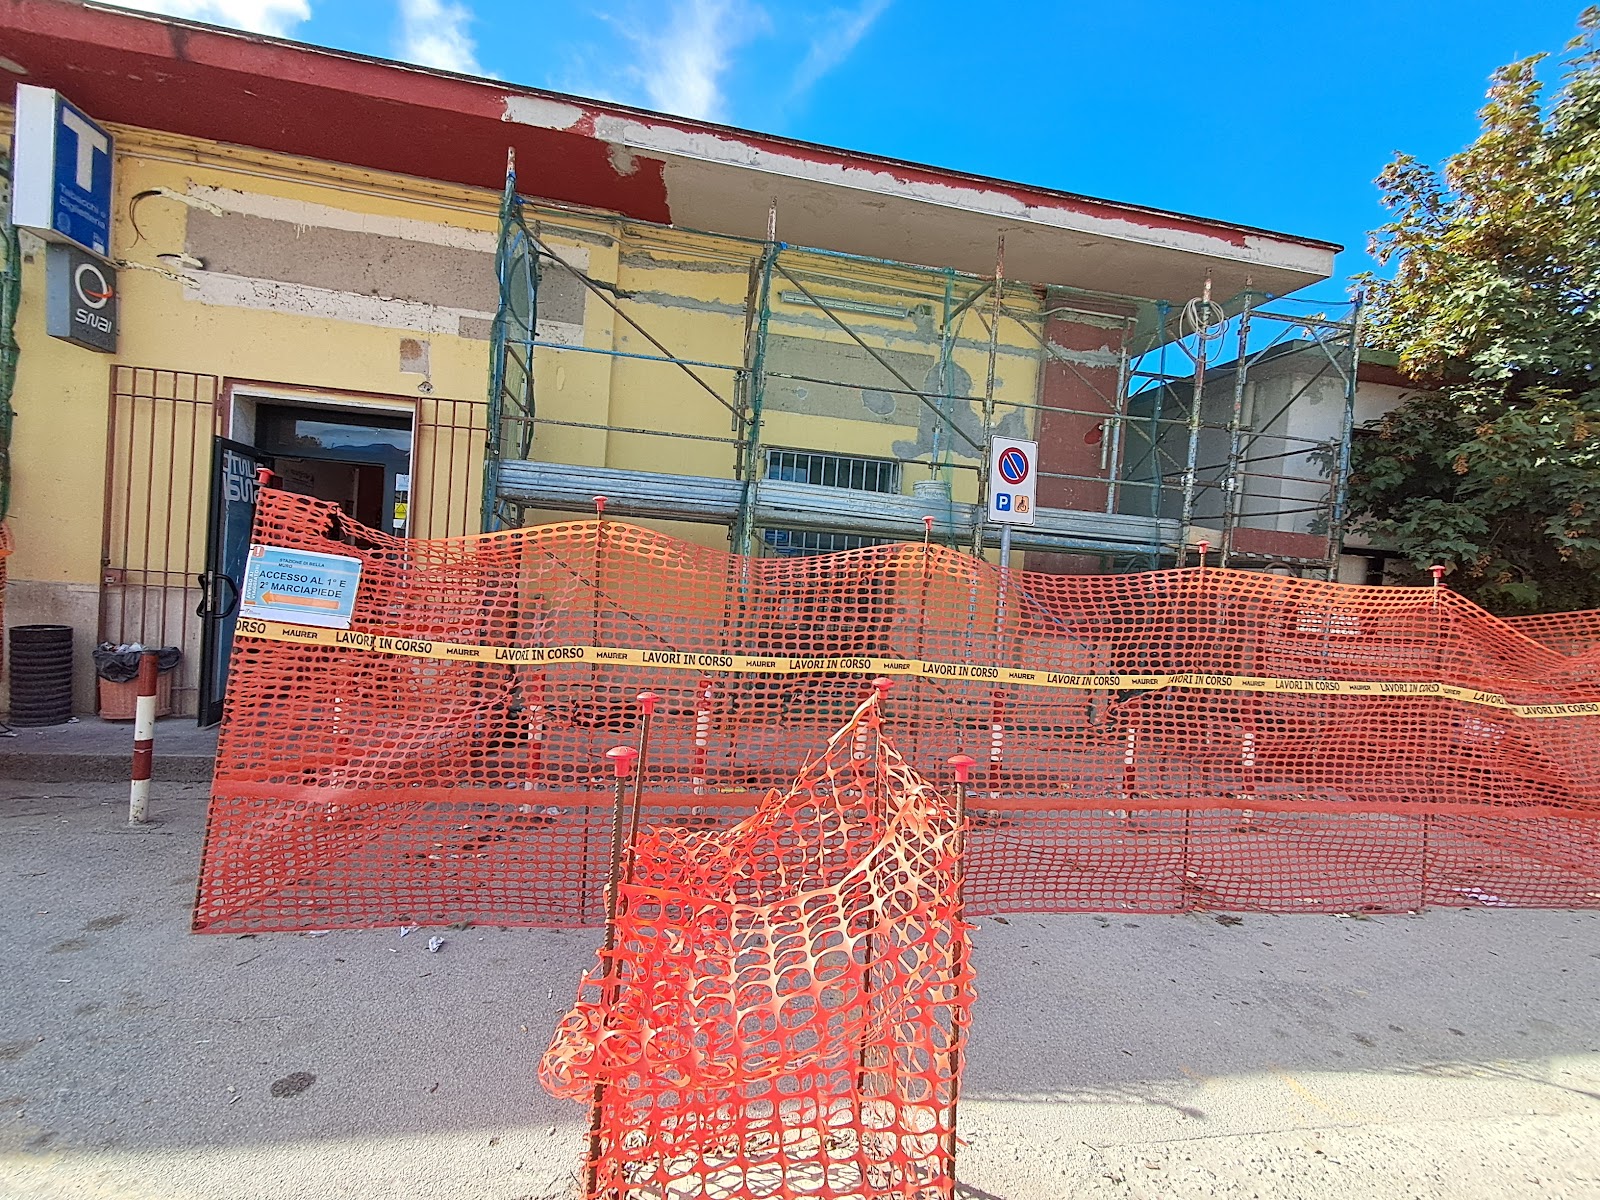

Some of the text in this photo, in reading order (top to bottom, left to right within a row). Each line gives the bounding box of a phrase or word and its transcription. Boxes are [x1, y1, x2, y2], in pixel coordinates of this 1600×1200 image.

[63, 106, 108, 193] T
[999, 495, 1009, 509] P
[259, 570, 308, 583] ACCESSO
[309, 576, 324, 585] AL
[339, 580, 347, 588] E
[245, 578, 253, 599] AVVISO
[270, 582, 342, 598] MARCIAPIEDE
[282, 629, 318, 639] MAURER
[379, 637, 392, 650] IN
[395, 639, 432, 653] CORSO
[446, 648, 480, 657] MAURER
[495, 647, 584, 661] LAVORI IN CORSO
[596, 652, 628, 660] MAURER
[642, 651, 733, 667] LAVORI IN CORSO
[745, 660, 776, 668] MAURER
[789, 659, 871, 670] LAVORI IN CORSO
[922, 663, 999, 678] LAVORI IN CORSO
[1008, 672, 1035, 680] MAURER
[1046, 674, 1120, 686] LAVORI IN CORSO
[1194, 675, 1204, 685] IN
[1205, 676, 1232, 687] CORSO
[1275, 680, 1340, 691] LAVORI IN CORSO
[1379, 683, 1440, 693] LAVORI IN CORSO
[1521, 706, 1552, 715] LAVORI
[1552, 705, 1566, 715] IN
[1567, 703, 1599, 713] CORSO
